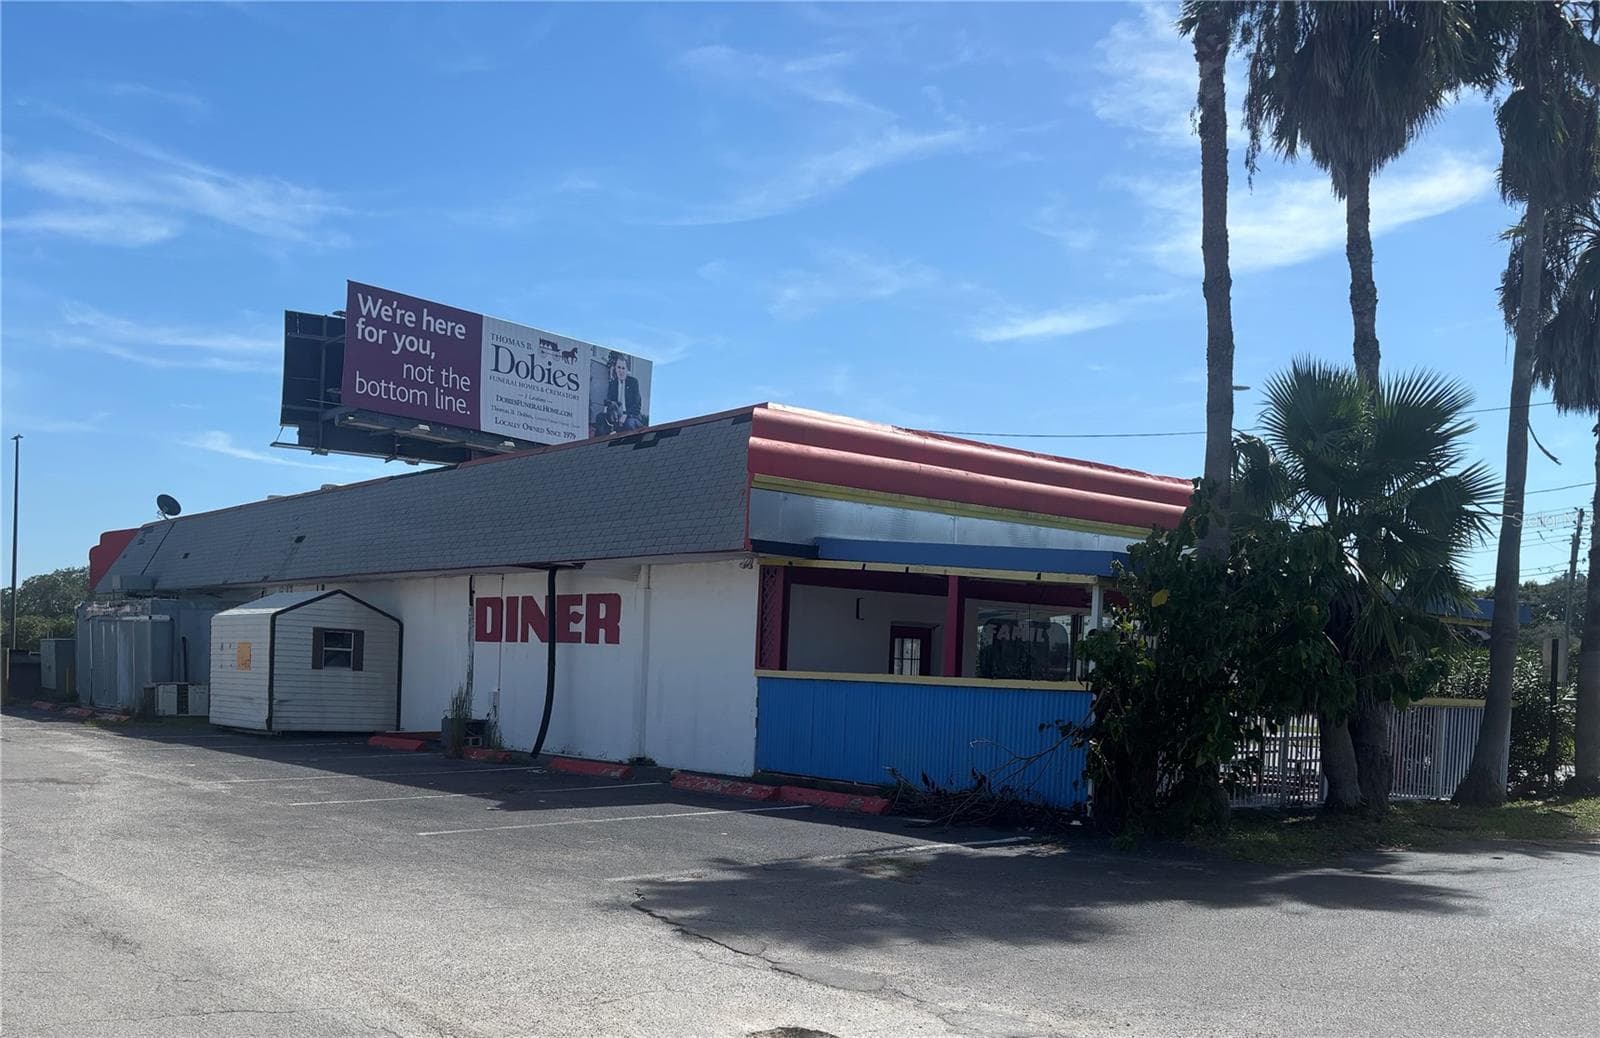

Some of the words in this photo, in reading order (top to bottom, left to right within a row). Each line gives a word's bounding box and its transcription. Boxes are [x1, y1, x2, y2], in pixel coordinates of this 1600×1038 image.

[357, 292, 416, 327] We're
[422, 308, 466, 339] here
[356, 317, 387, 344] for
[391, 332, 435, 359] you,
[490, 333, 526, 349] THOMAS
[403, 363, 434, 384] not
[441, 367, 470, 391] the
[489, 375, 517, 388] FUNERAL
[518, 382, 540, 392] HOMES
[490, 343, 580, 392] Dobies
[355, 370, 428, 406] bottom
[435, 387, 471, 415] line.
[475, 593, 622, 644] DINER
